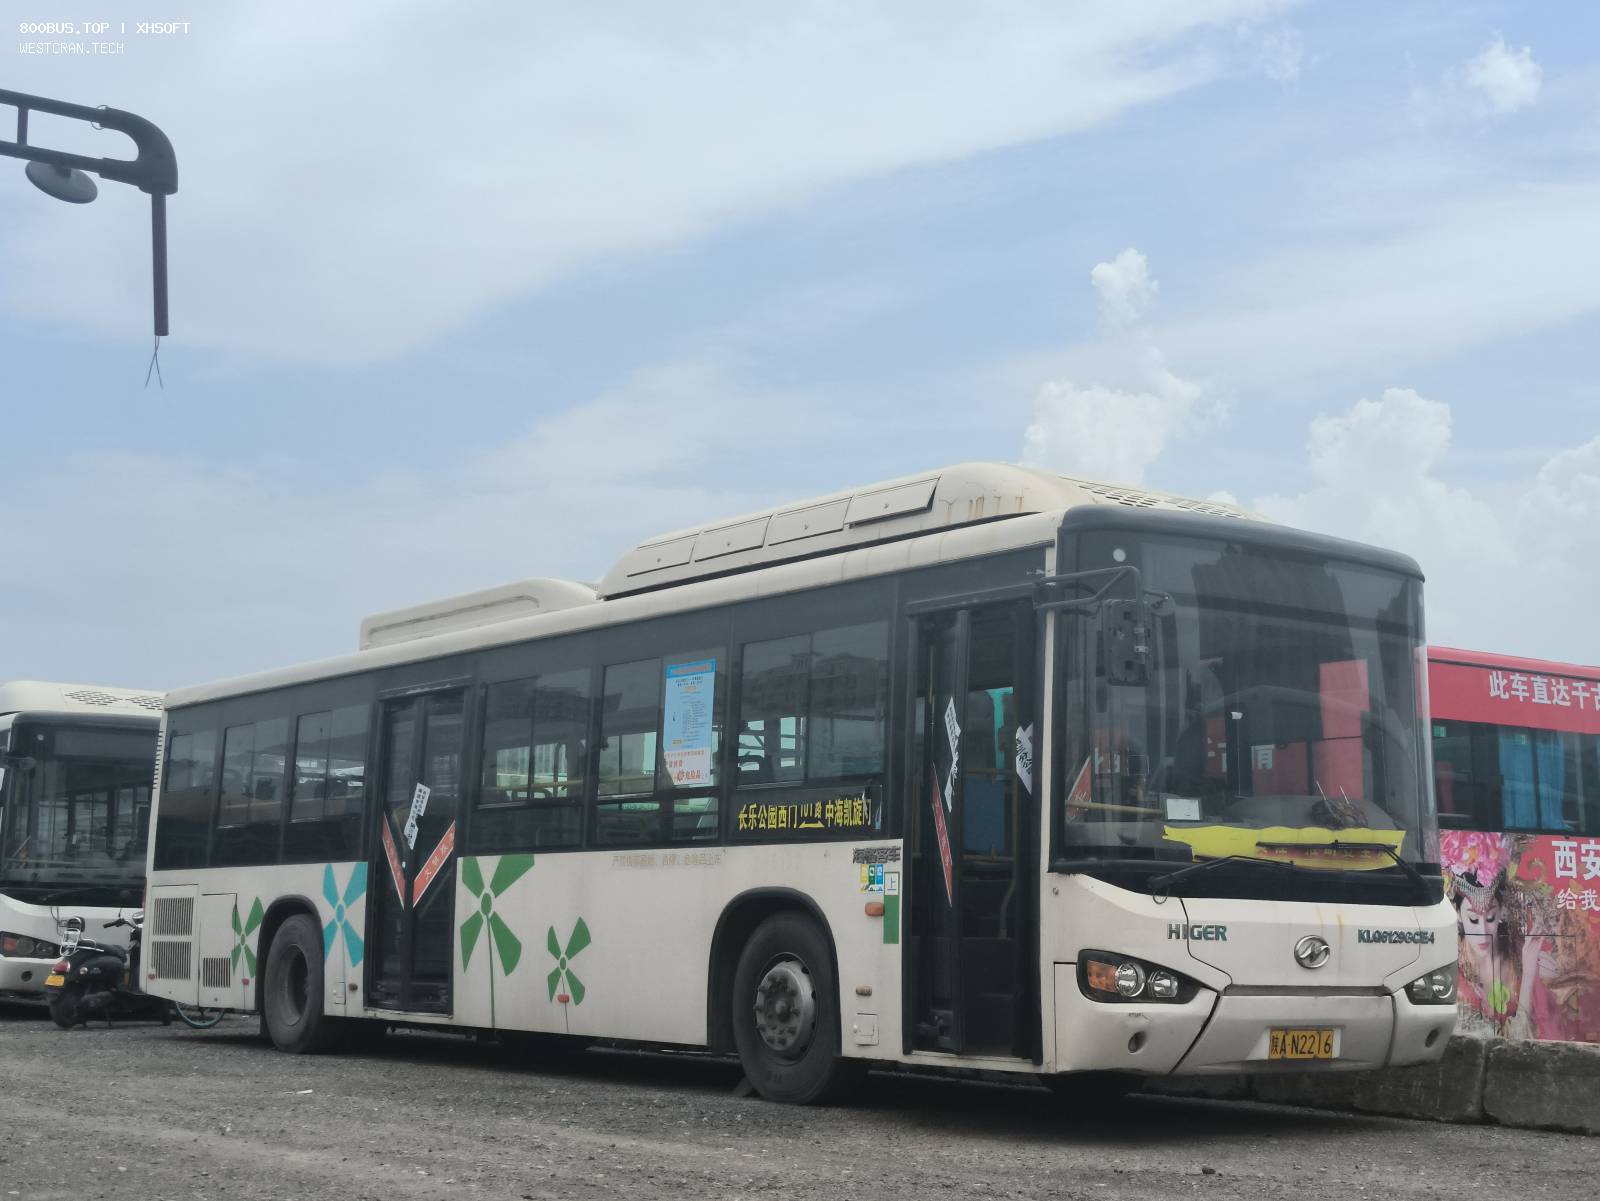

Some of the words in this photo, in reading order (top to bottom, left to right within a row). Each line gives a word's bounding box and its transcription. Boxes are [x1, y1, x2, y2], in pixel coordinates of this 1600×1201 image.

[738, 803, 798, 831] 长乐公园西门
[825, 798, 872, 828] 中海凯旋门
[1552, 840, 1600, 880] 西安
[887, 876, 896, 891] 上
[1557, 888, 1600, 911] 给我
[1167, 923, 1227, 941] HIGER
